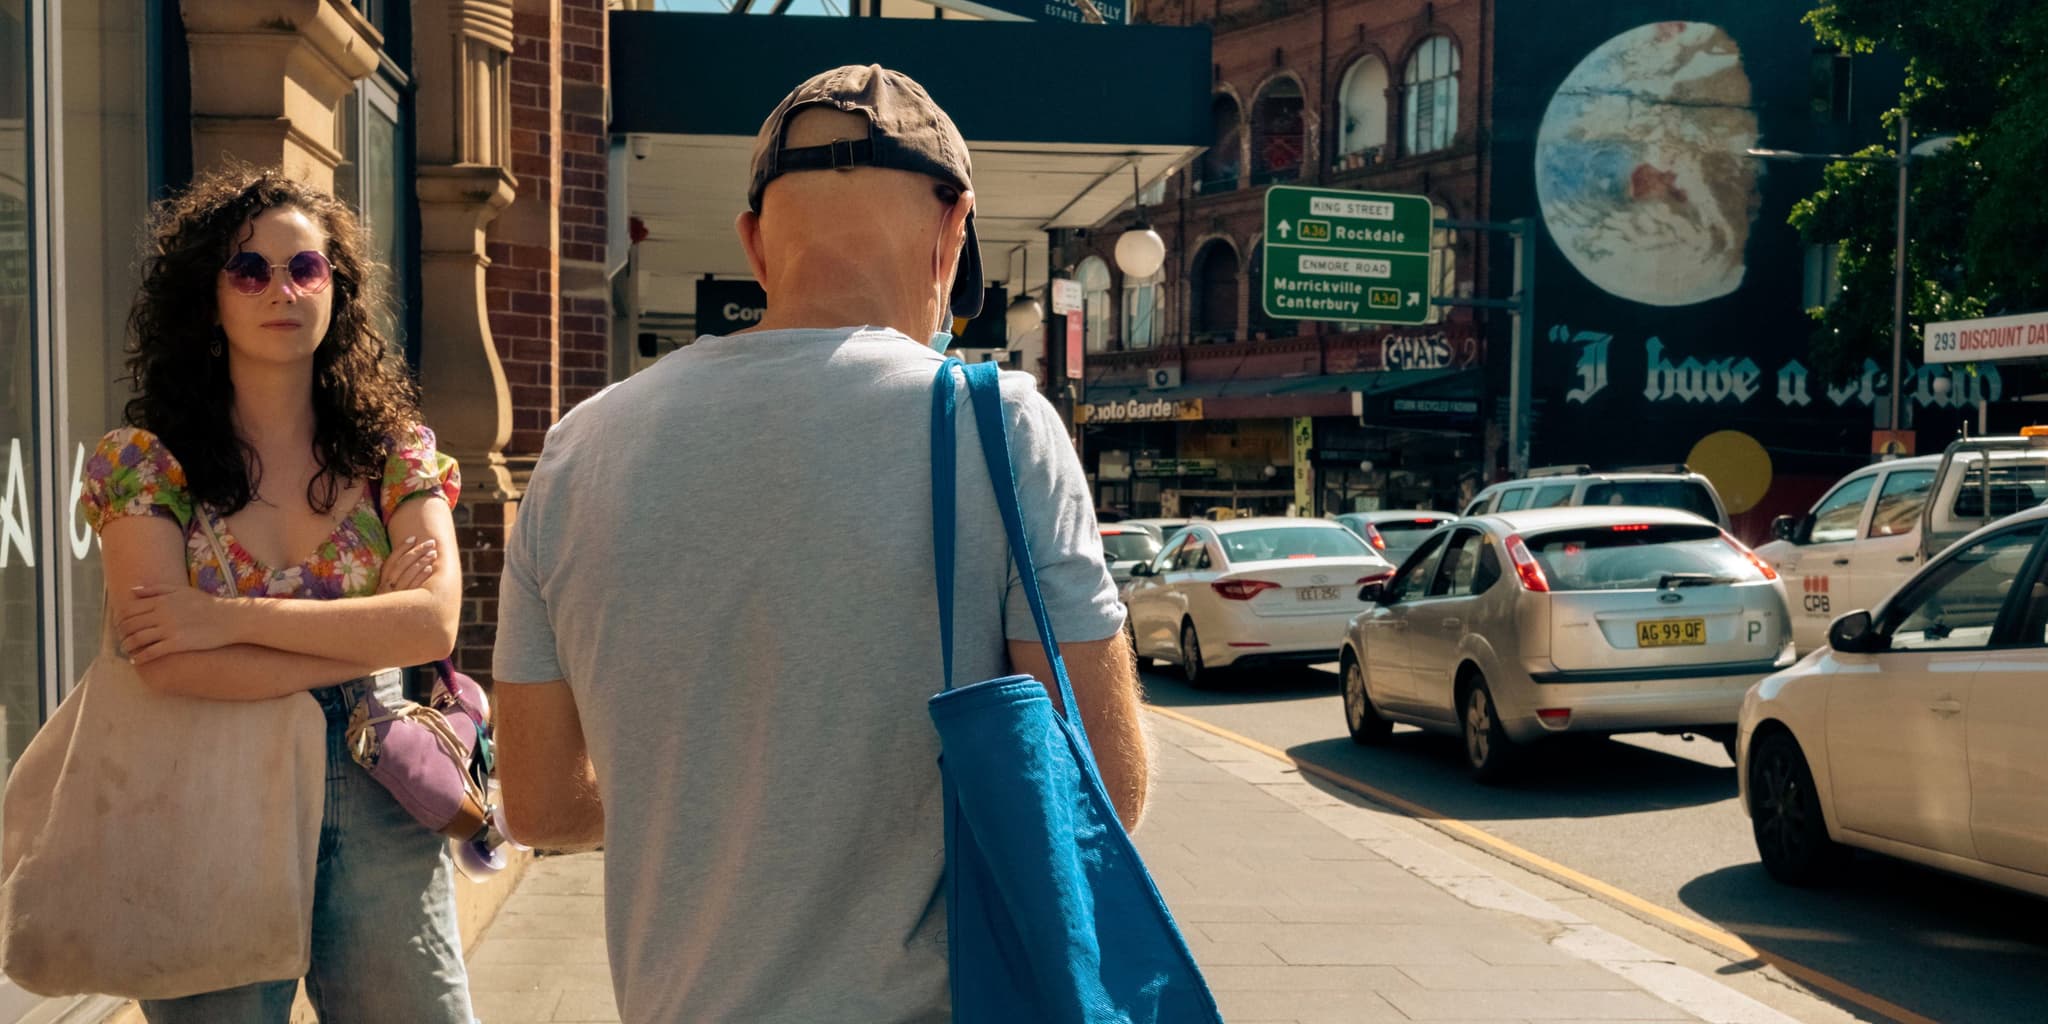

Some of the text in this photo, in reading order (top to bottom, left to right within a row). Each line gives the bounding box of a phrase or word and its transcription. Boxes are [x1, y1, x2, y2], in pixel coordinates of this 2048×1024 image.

[1045, 4, 1078, 23] ESTATE
[1093, 1, 1122, 20] ELLY
[1314, 202, 1389, 217] KING STREET
[1302, 225, 1405, 243] A36 Rockdale
[1302, 259, 1388, 274] ENMORE ROAD
[1274, 277, 1362, 294] Marrickville
[1276, 295, 1360, 314] Canterbury
[1373, 293, 1396, 304] A34
[1934, 323, 2048, 351] 293 DISCOUNT DA
[1643, 336, 1760, 403] have
[1776, 359, 1812, 406] a
[1804, 594, 1830, 612] CPB
[1641, 625, 1659, 641] AG
[1663, 624, 1681, 639] 99
[1747, 620, 1762, 642] P
